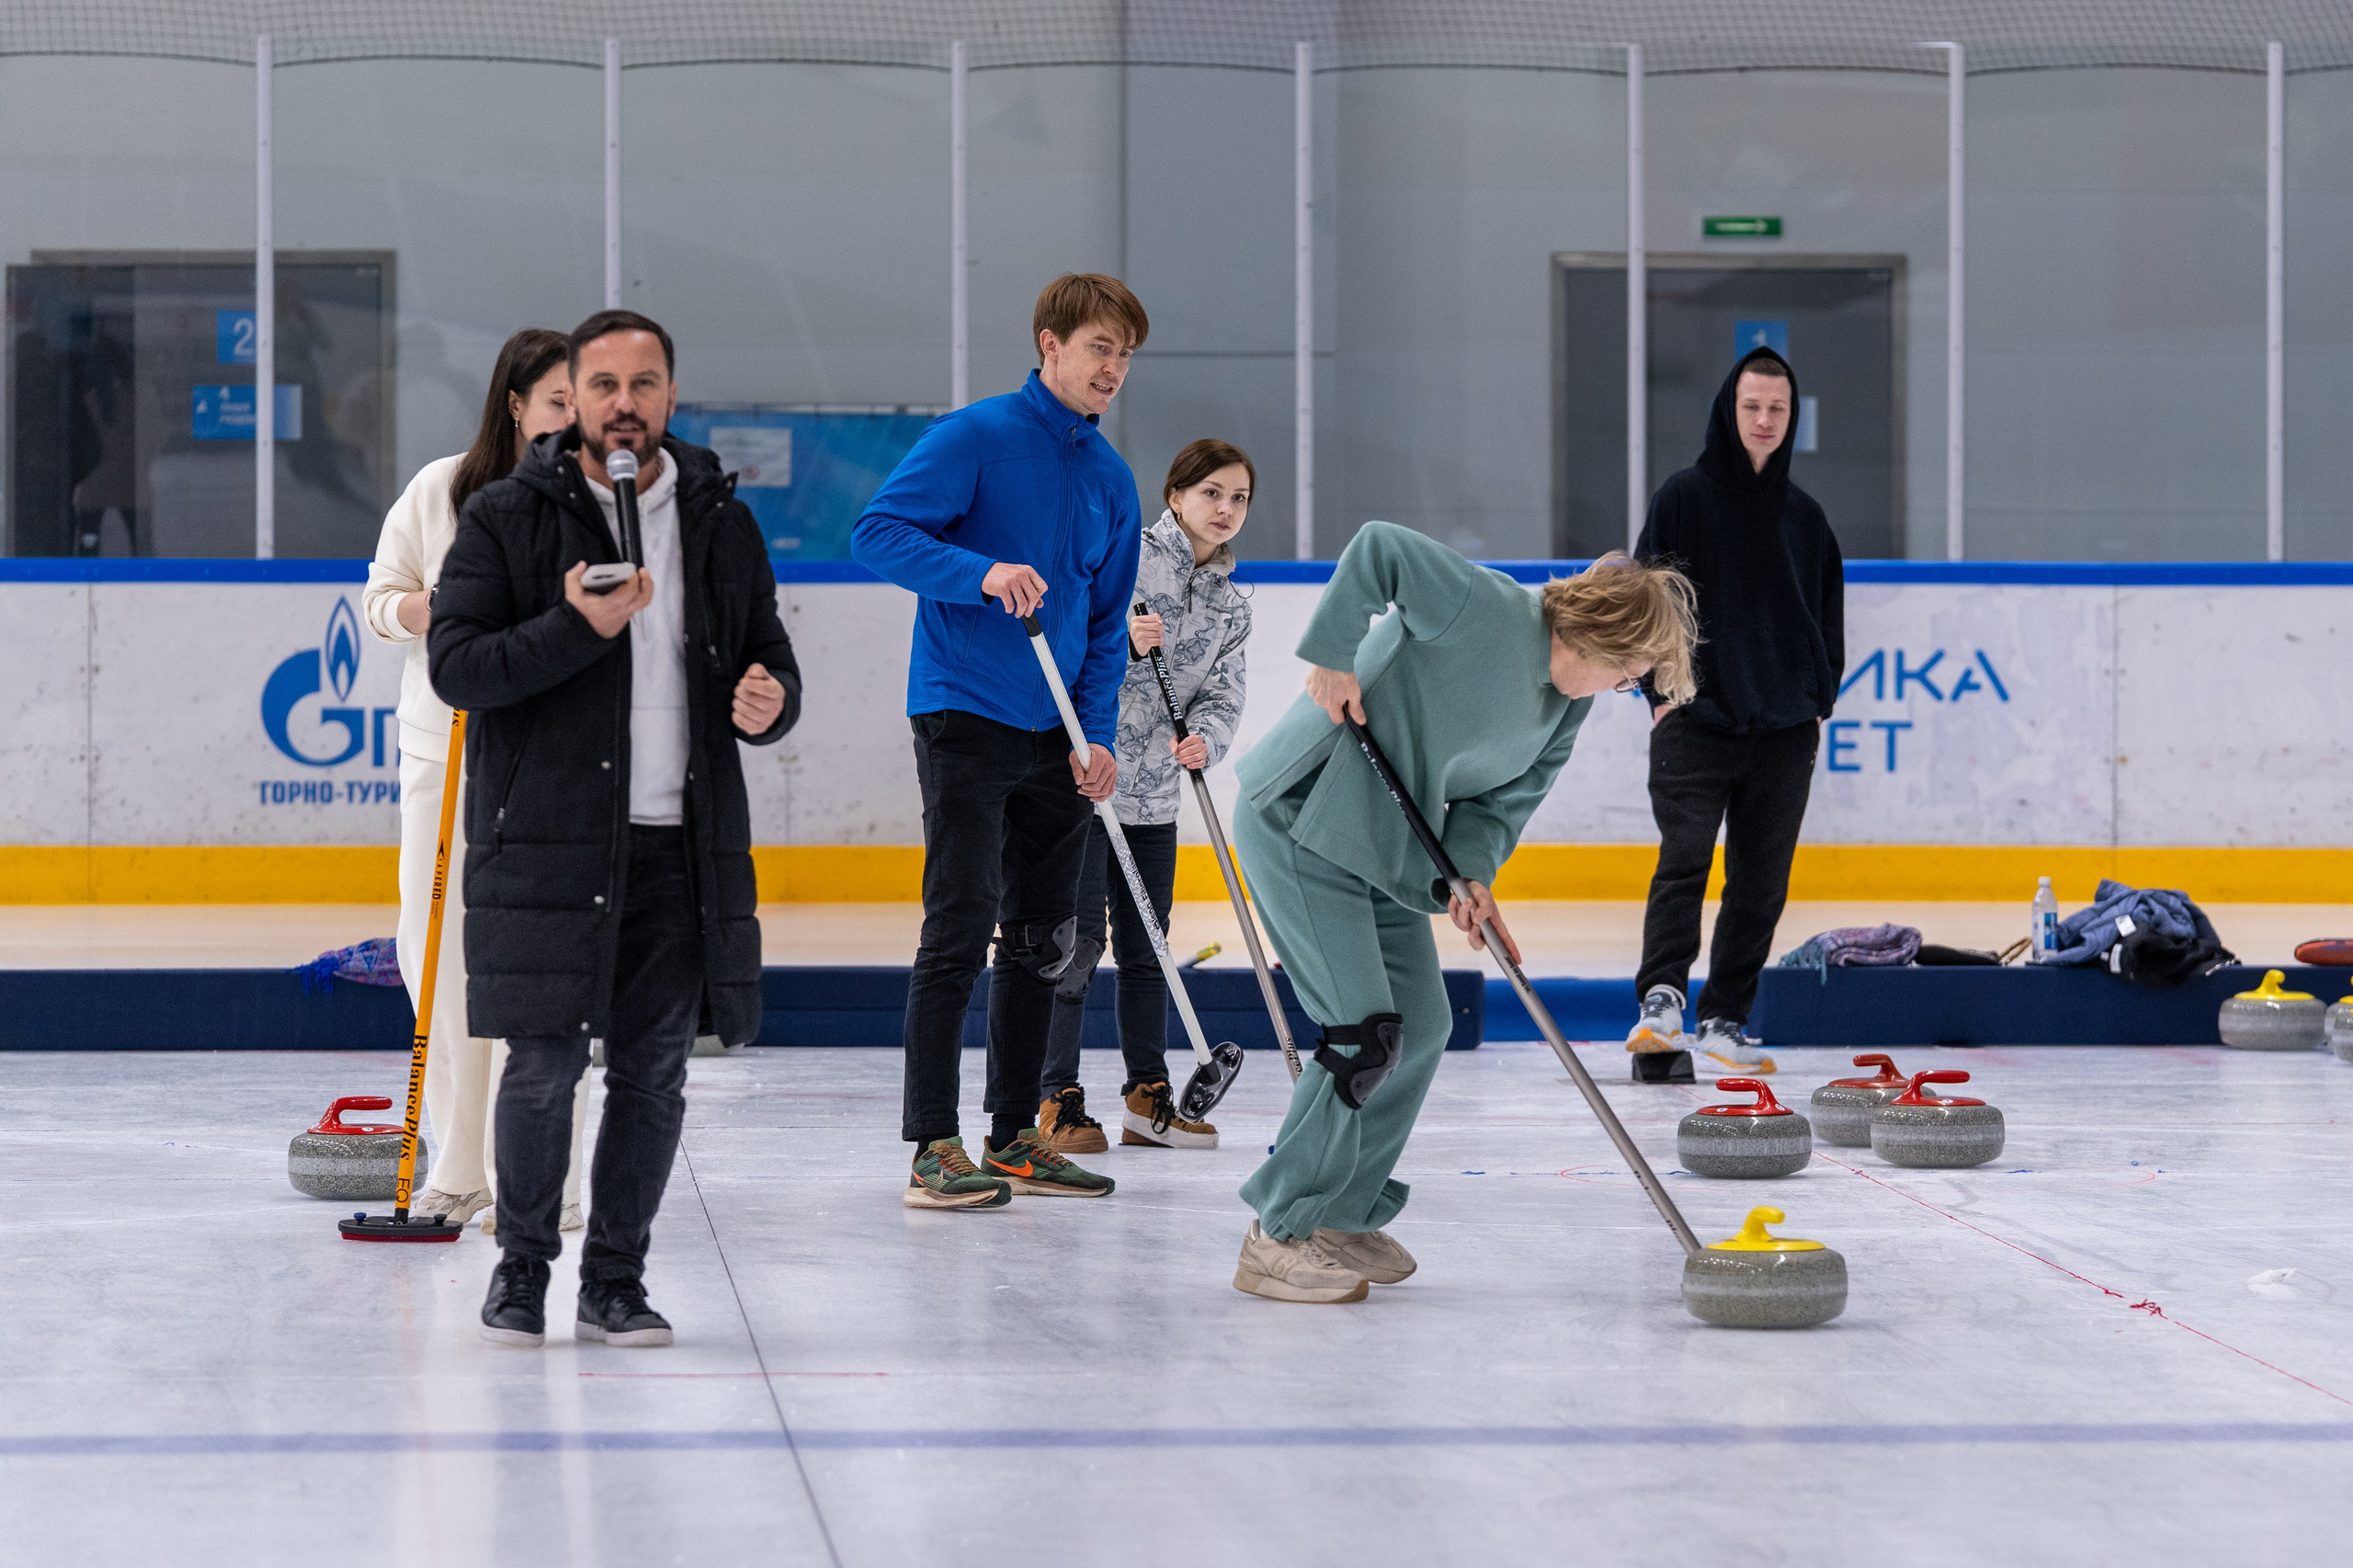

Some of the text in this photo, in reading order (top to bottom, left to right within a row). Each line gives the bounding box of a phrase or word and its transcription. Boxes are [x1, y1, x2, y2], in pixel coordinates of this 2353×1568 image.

[233, 317, 256, 357] 2
[1156, 655, 1183, 721] BalancePlus
[395, 1034, 427, 1203] BalancePlus EQ
